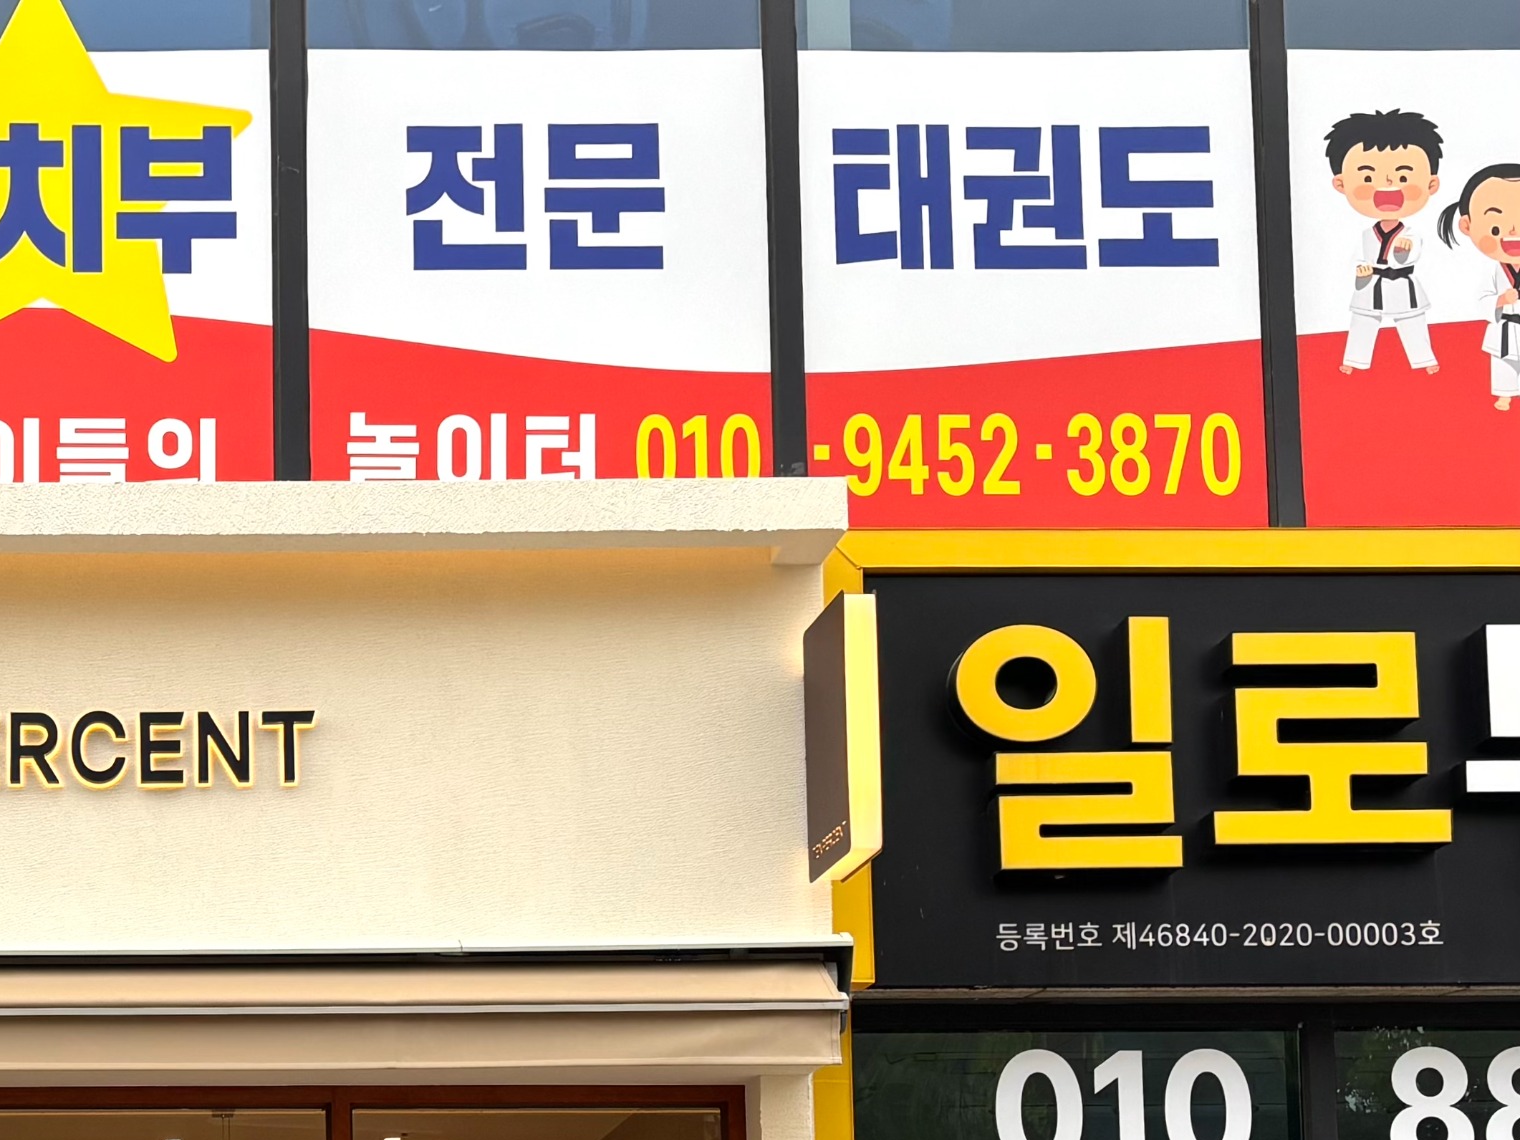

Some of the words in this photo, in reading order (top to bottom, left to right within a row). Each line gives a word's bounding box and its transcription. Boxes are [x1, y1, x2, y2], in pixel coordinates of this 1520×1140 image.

[404, 123, 665, 271] 전문
[832, 124, 1220, 271] 태권도
[348, 413, 596, 481] 놀이터
[956, 615, 1453, 870] 일로
[996, 924, 1103, 951] 등록번호
[1112, 920, 1444, 951] 제46840-2020-00003호
